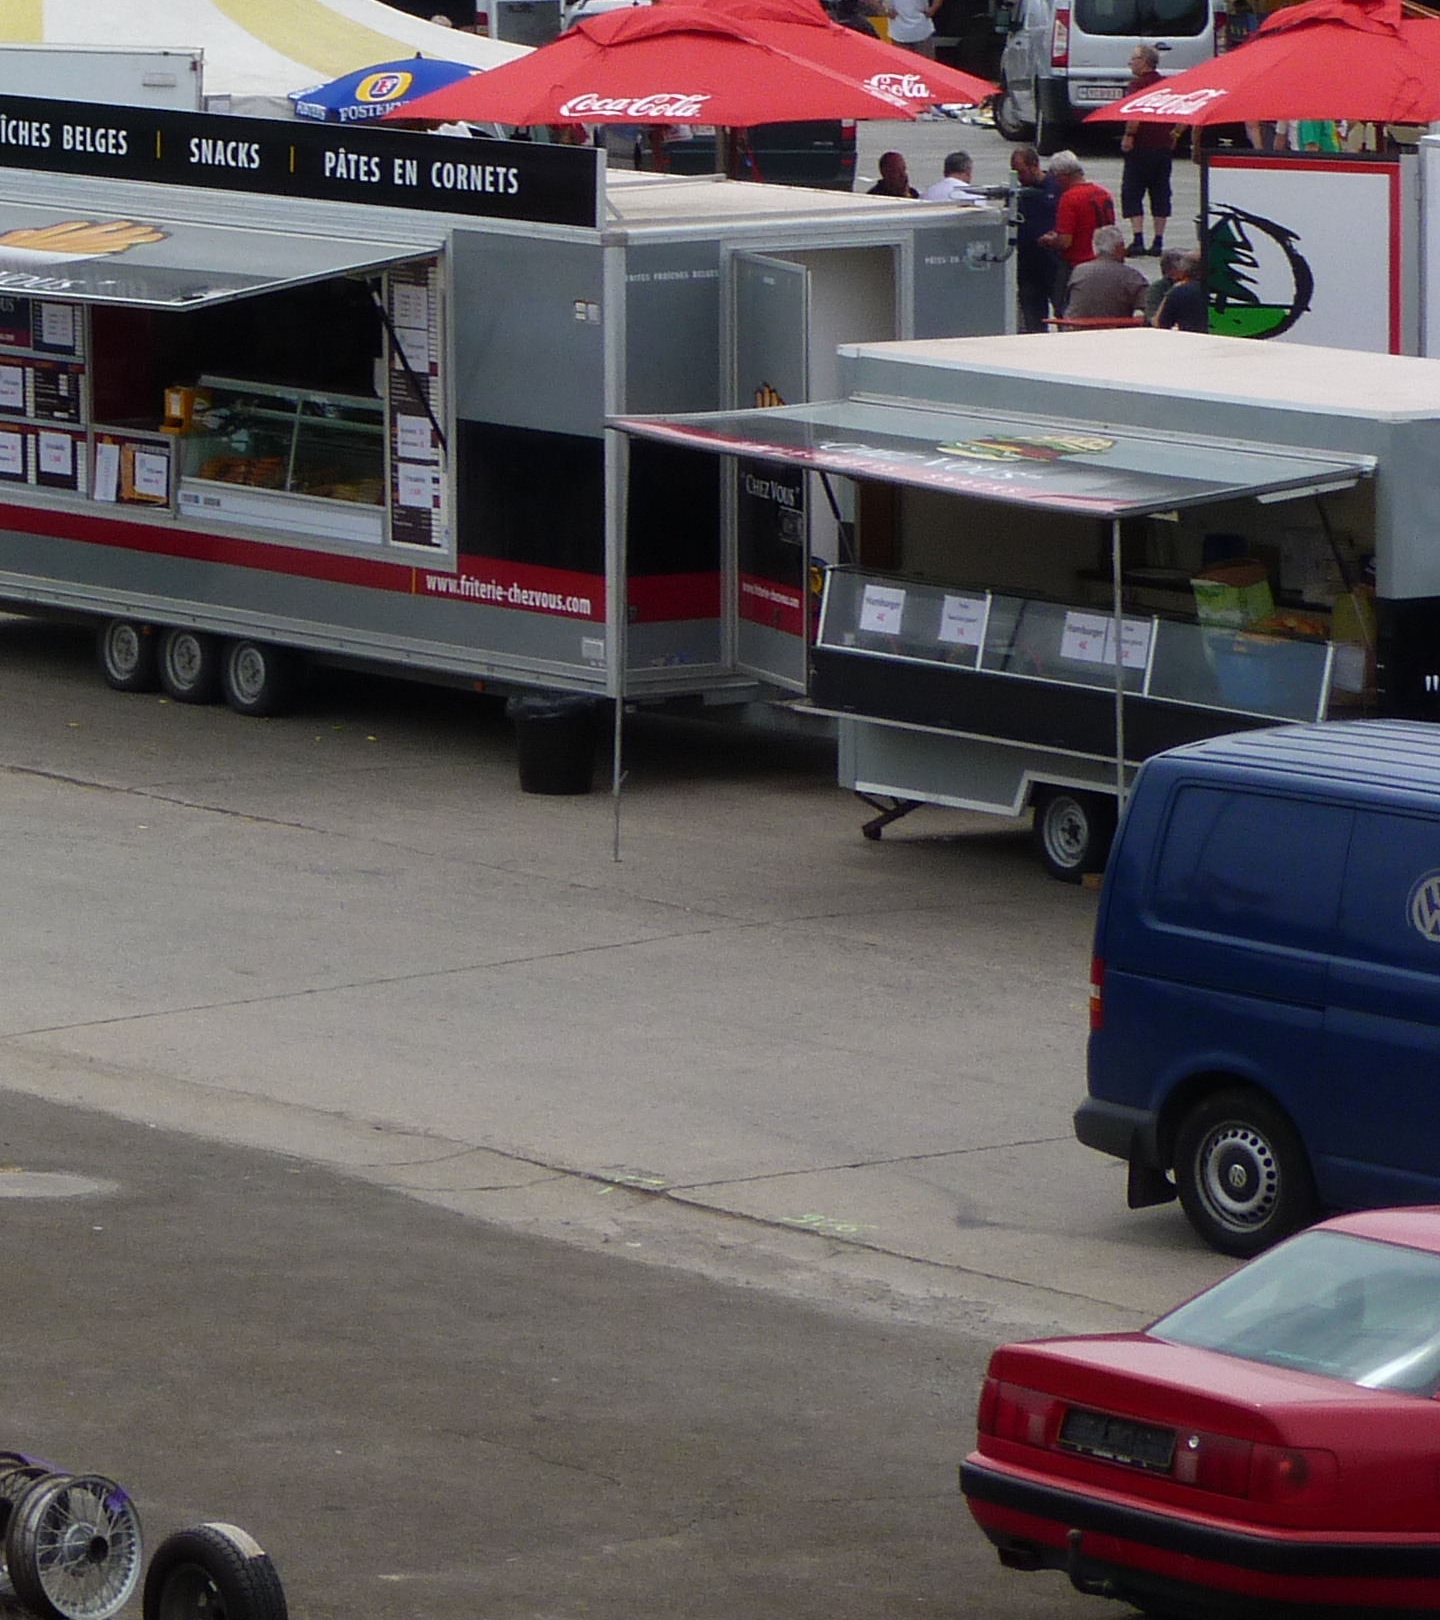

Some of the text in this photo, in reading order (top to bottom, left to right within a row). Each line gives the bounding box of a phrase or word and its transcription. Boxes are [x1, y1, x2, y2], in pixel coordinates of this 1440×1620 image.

[560, 93, 711, 118] Coca-Cola
[62, 125, 128, 156] BELGES
[189, 137, 261, 169] SNACKS
[324, 147, 380, 183] PÂTES
[393, 158, 418, 186] EN
[431, 161, 519, 194] CORNETS
[426, 574, 592, 615] www.friterie-chezvous.com
